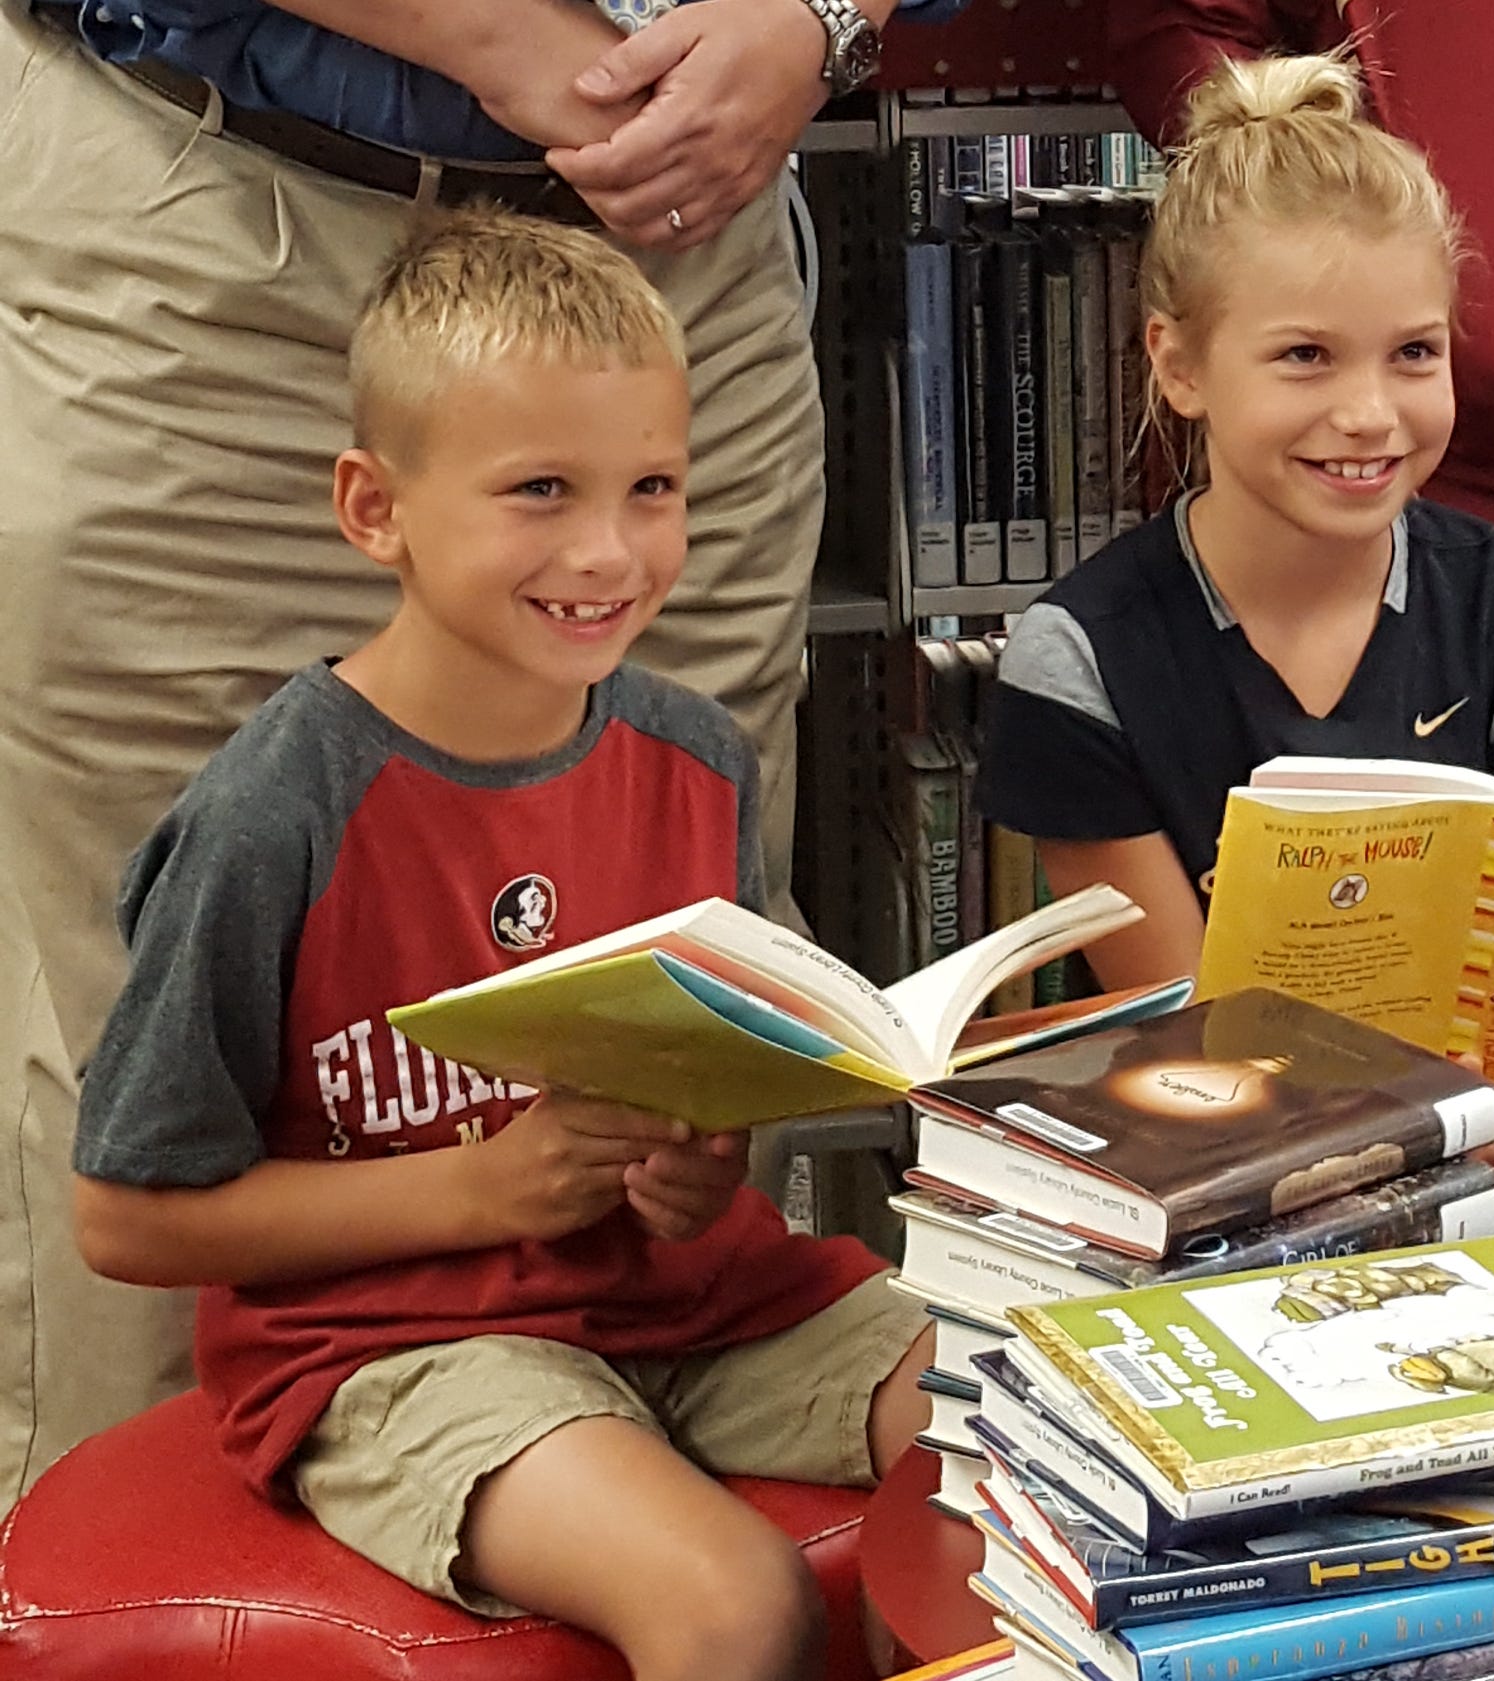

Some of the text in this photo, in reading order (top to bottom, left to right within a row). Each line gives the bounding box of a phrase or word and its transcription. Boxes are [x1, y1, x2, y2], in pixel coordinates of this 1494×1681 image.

[1017, 332, 1031, 367] THE
[1014, 370, 1036, 499] SCOURGE
[931, 838, 958, 946] BAMBOO
[1358, 1465, 1394, 1485] Frog
[1397, 1457, 1424, 1475] and
[1427, 1451, 1464, 1472] Toad
[1466, 1447, 1490, 1466] All
[1236, 1488, 1260, 1504] Can
[1130, 1588, 1179, 1609] TORREY
[1182, 1576, 1267, 1600] MALDONADO
